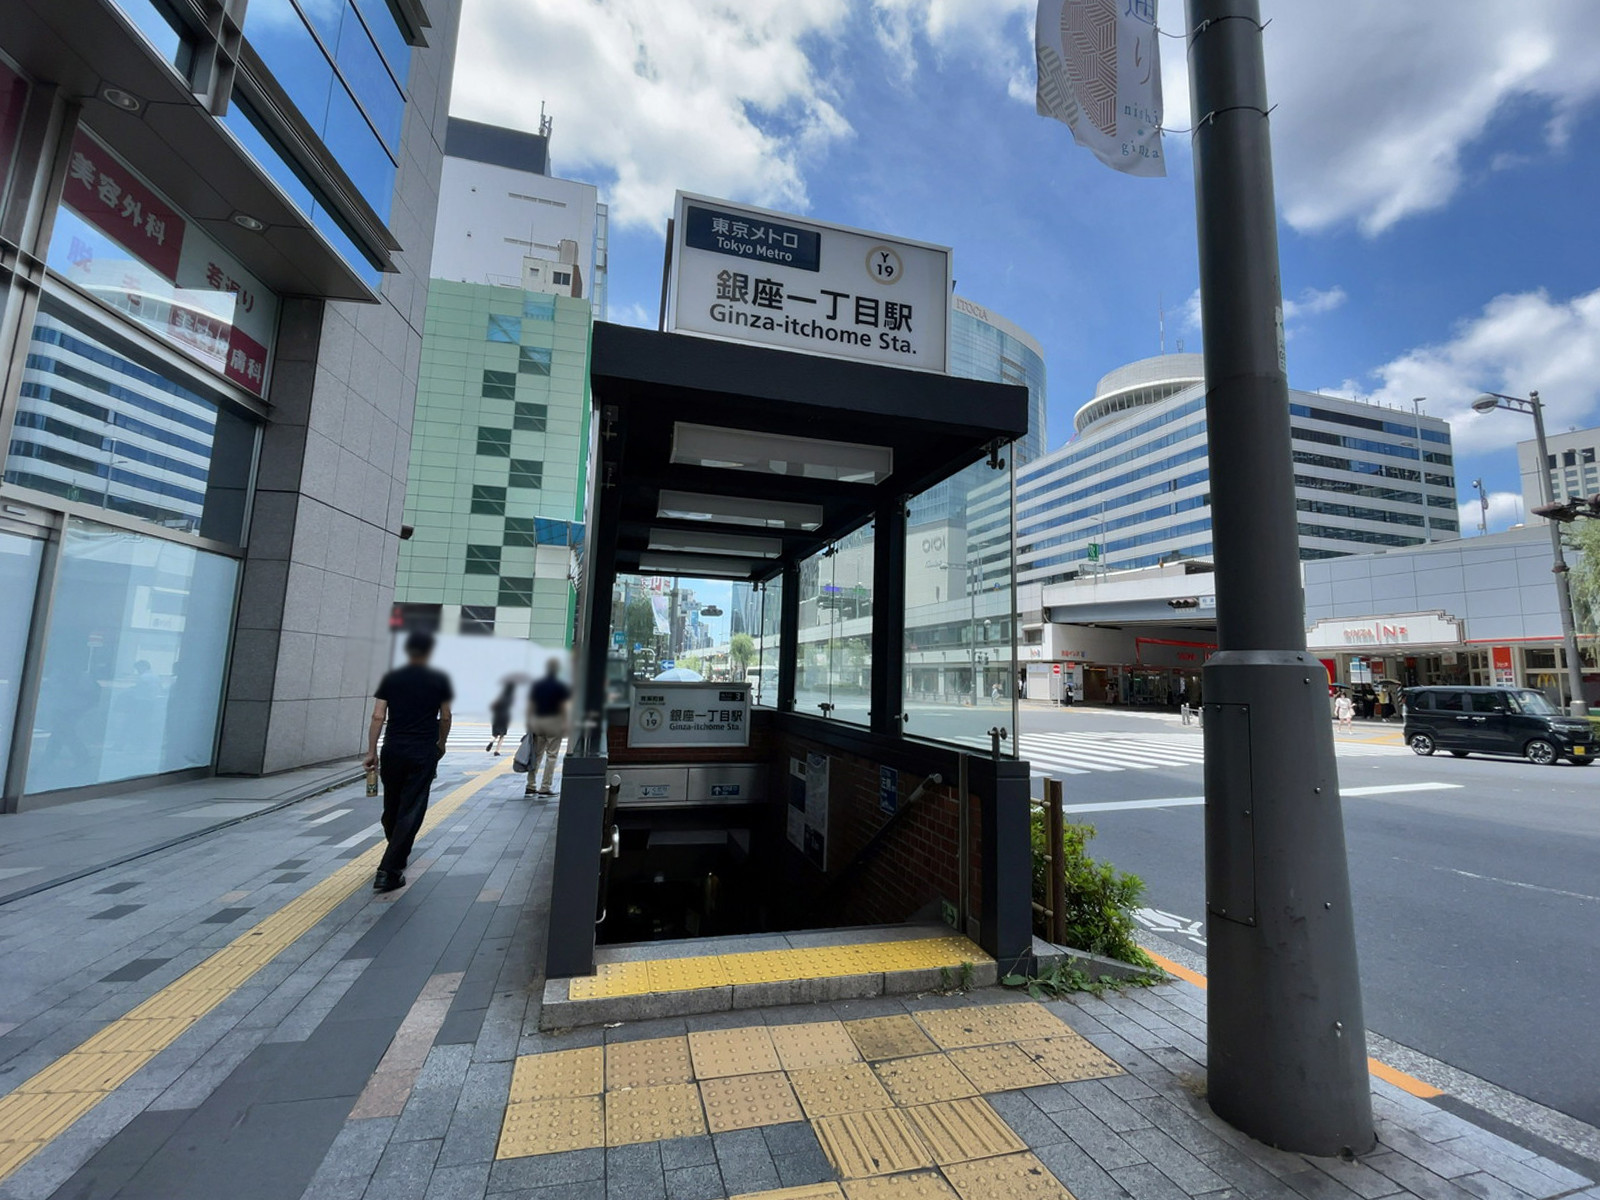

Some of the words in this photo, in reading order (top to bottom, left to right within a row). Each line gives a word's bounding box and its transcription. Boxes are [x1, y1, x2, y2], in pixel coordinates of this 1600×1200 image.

[1124, 102, 1159, 124] nishi
[1121, 140, 1160, 158] ginza
[70, 152, 166, 246] 美容外科
[711, 217, 798, 249] 東京メトロ
[716, 236, 754, 255] Tokyo
[755, 244, 793, 262] Metro
[880, 251, 890, 263] Y
[876, 263, 895, 277] 19
[716, 269, 913, 333] 銀座一丁目駅
[709, 303, 872, 347] Ginza-itchome
[879, 332, 917, 355] Sta.
[646, 719, 657, 727] 19
[670, 709, 743, 722] 銀座一丁目駅
[669, 722, 725, 731] Ginza-itchome
[727, 722, 742, 731] Sta.
